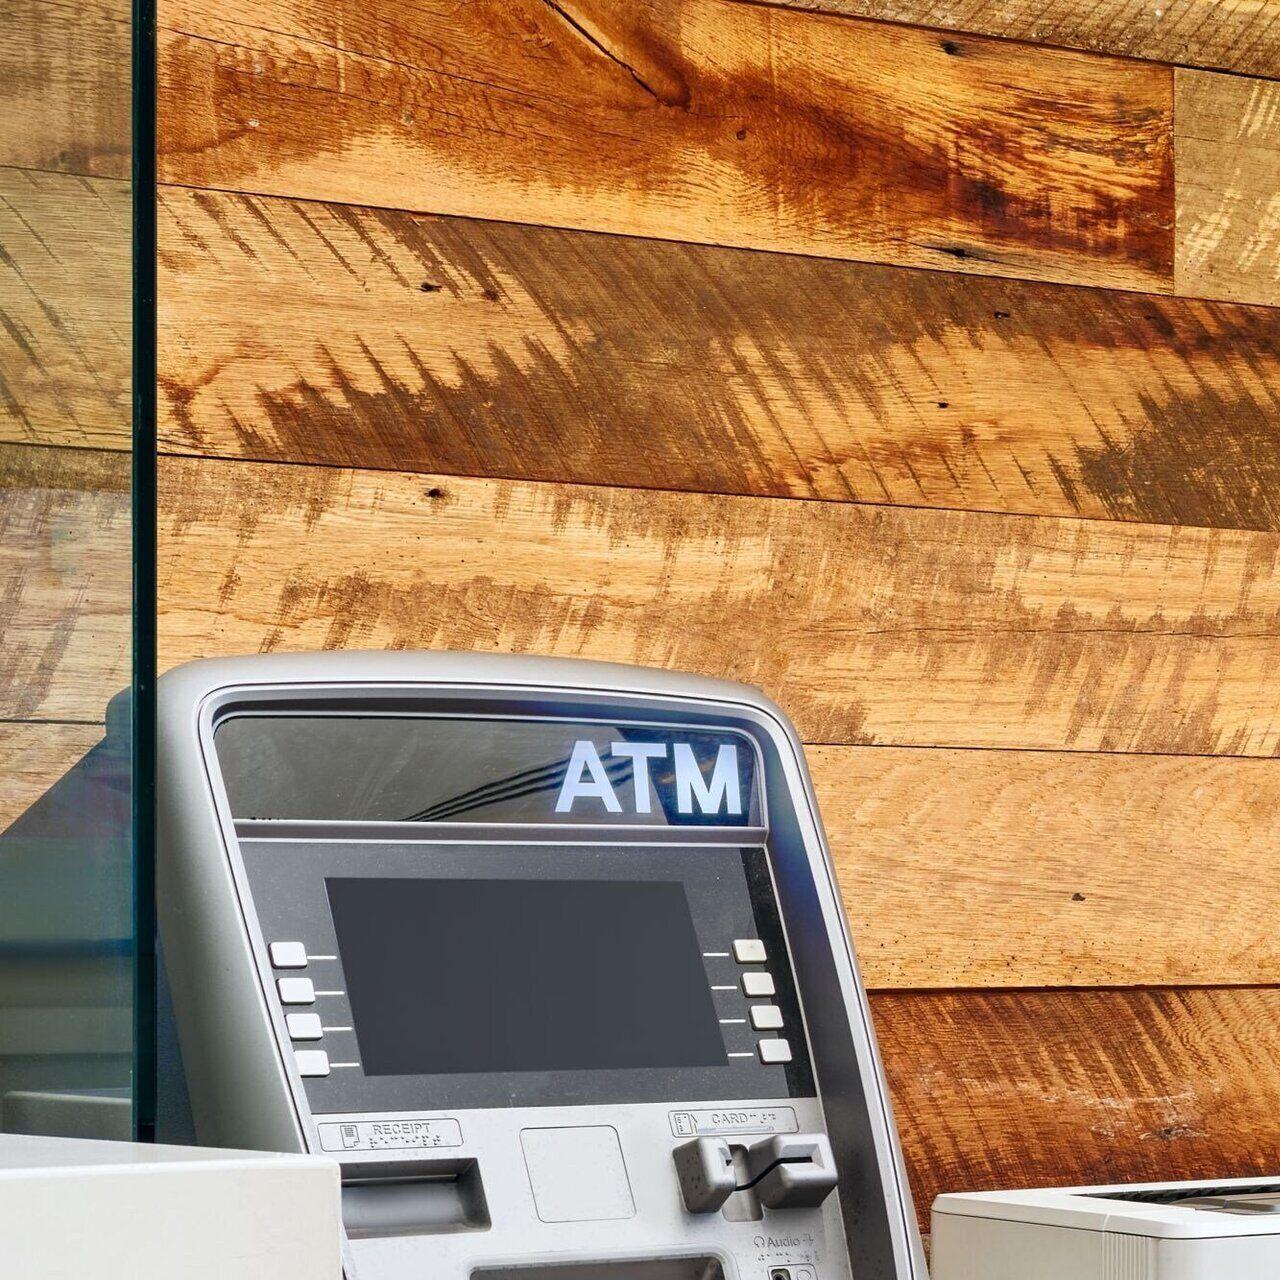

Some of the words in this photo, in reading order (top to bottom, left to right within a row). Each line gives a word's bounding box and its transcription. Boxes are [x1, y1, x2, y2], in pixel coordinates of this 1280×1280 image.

[555, 740, 742, 814] ATM
[711, 1113, 748, 1124] CARD
[372, 1122, 430, 1135] RECEIPT
[767, 1236, 800, 1248] Audio
